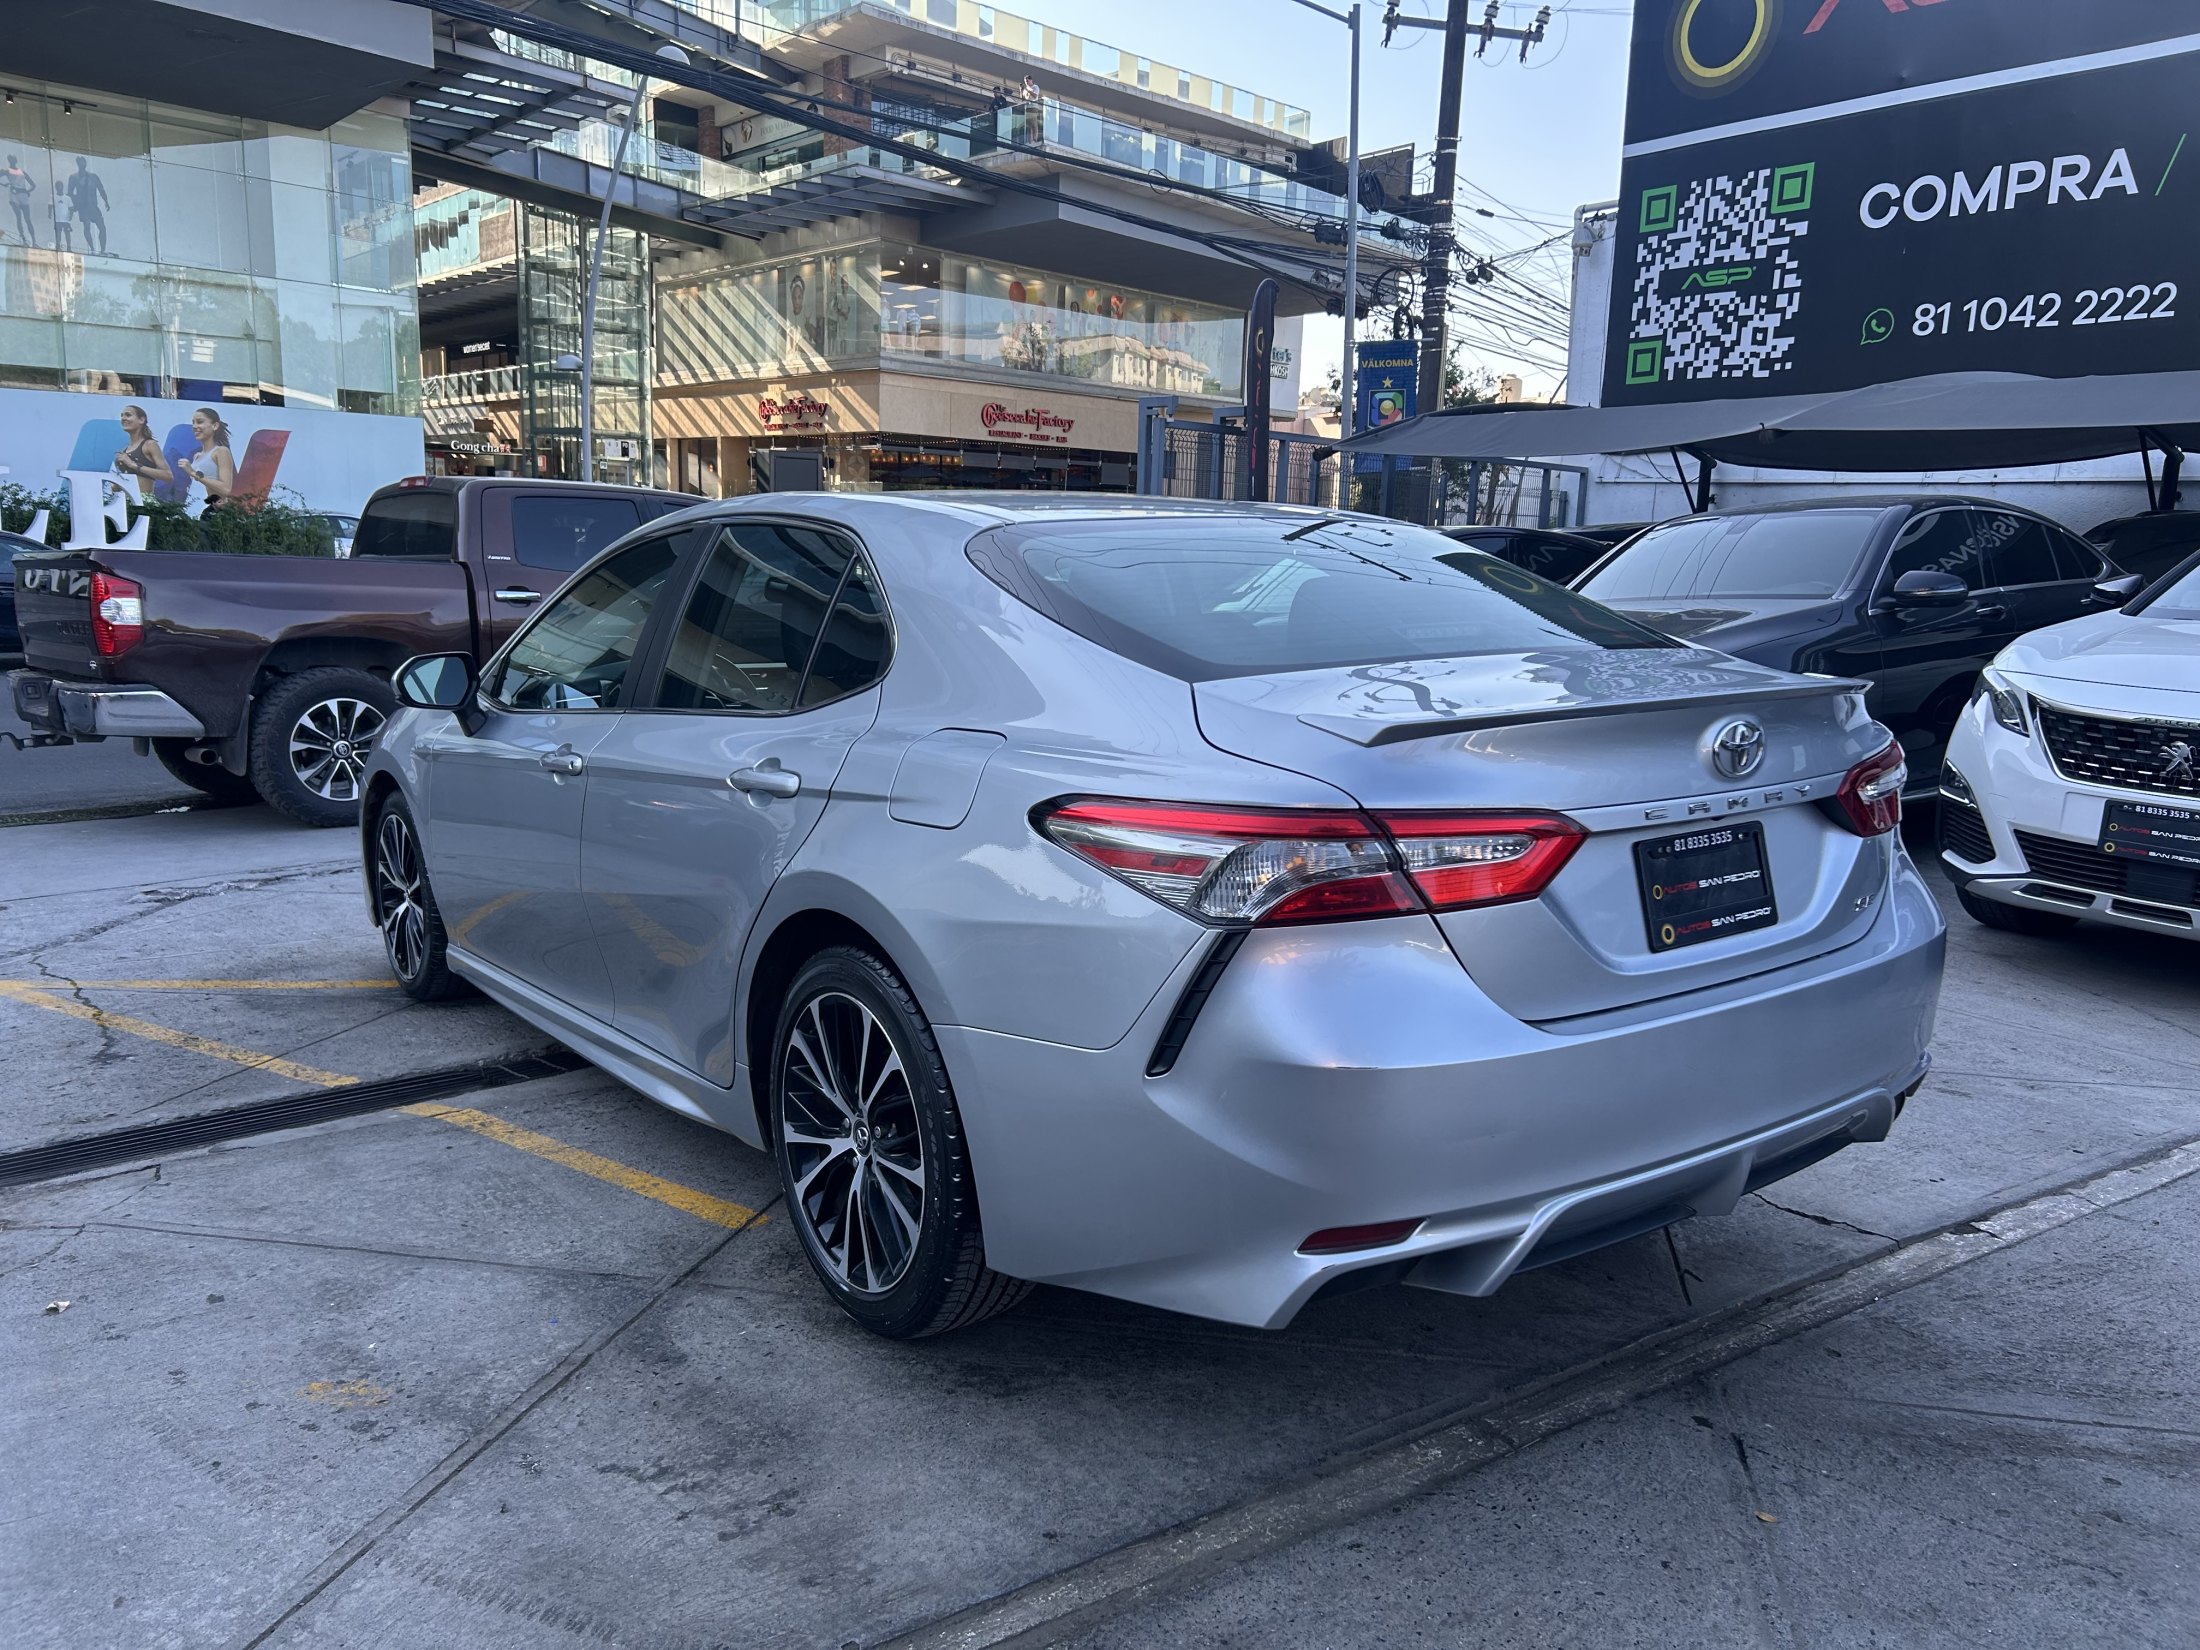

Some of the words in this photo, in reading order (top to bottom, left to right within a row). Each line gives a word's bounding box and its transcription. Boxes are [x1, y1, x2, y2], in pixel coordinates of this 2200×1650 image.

[1859, 147, 2139, 229] COMPRA
[1911, 301, 1952, 337] 81
[1962, 293, 2062, 332] 1042
[2071, 281, 2178, 326] 2222
[1361, 357, 1415, 369] VÄLKOMNA
[981, 402, 1038, 429] Cheesecake
[1032, 408, 1075, 433] Factory
[451, 440, 480, 454] Gong
[481, 442, 500, 453] cha
[1644, 785, 1812, 821] CAMRY
[2135, 805, 2146, 813] 81
[2147, 807, 2168, 816] 8335
[2169, 809, 2190, 819] 3535
[1674, 839, 1686, 851] 81
[1687, 835, 1710, 849] 8335
[1710, 830, 1733, 845] 3535
[2174, 833, 2200, 841] PEDR
[2171, 854, 2200, 863] PEDR
[1698, 876, 1723, 888] SAN
[1723, 870, 1761, 884] PEDRO
[1711, 915, 1735, 927] SAN
[1734, 906, 1772, 922] PEDRO
